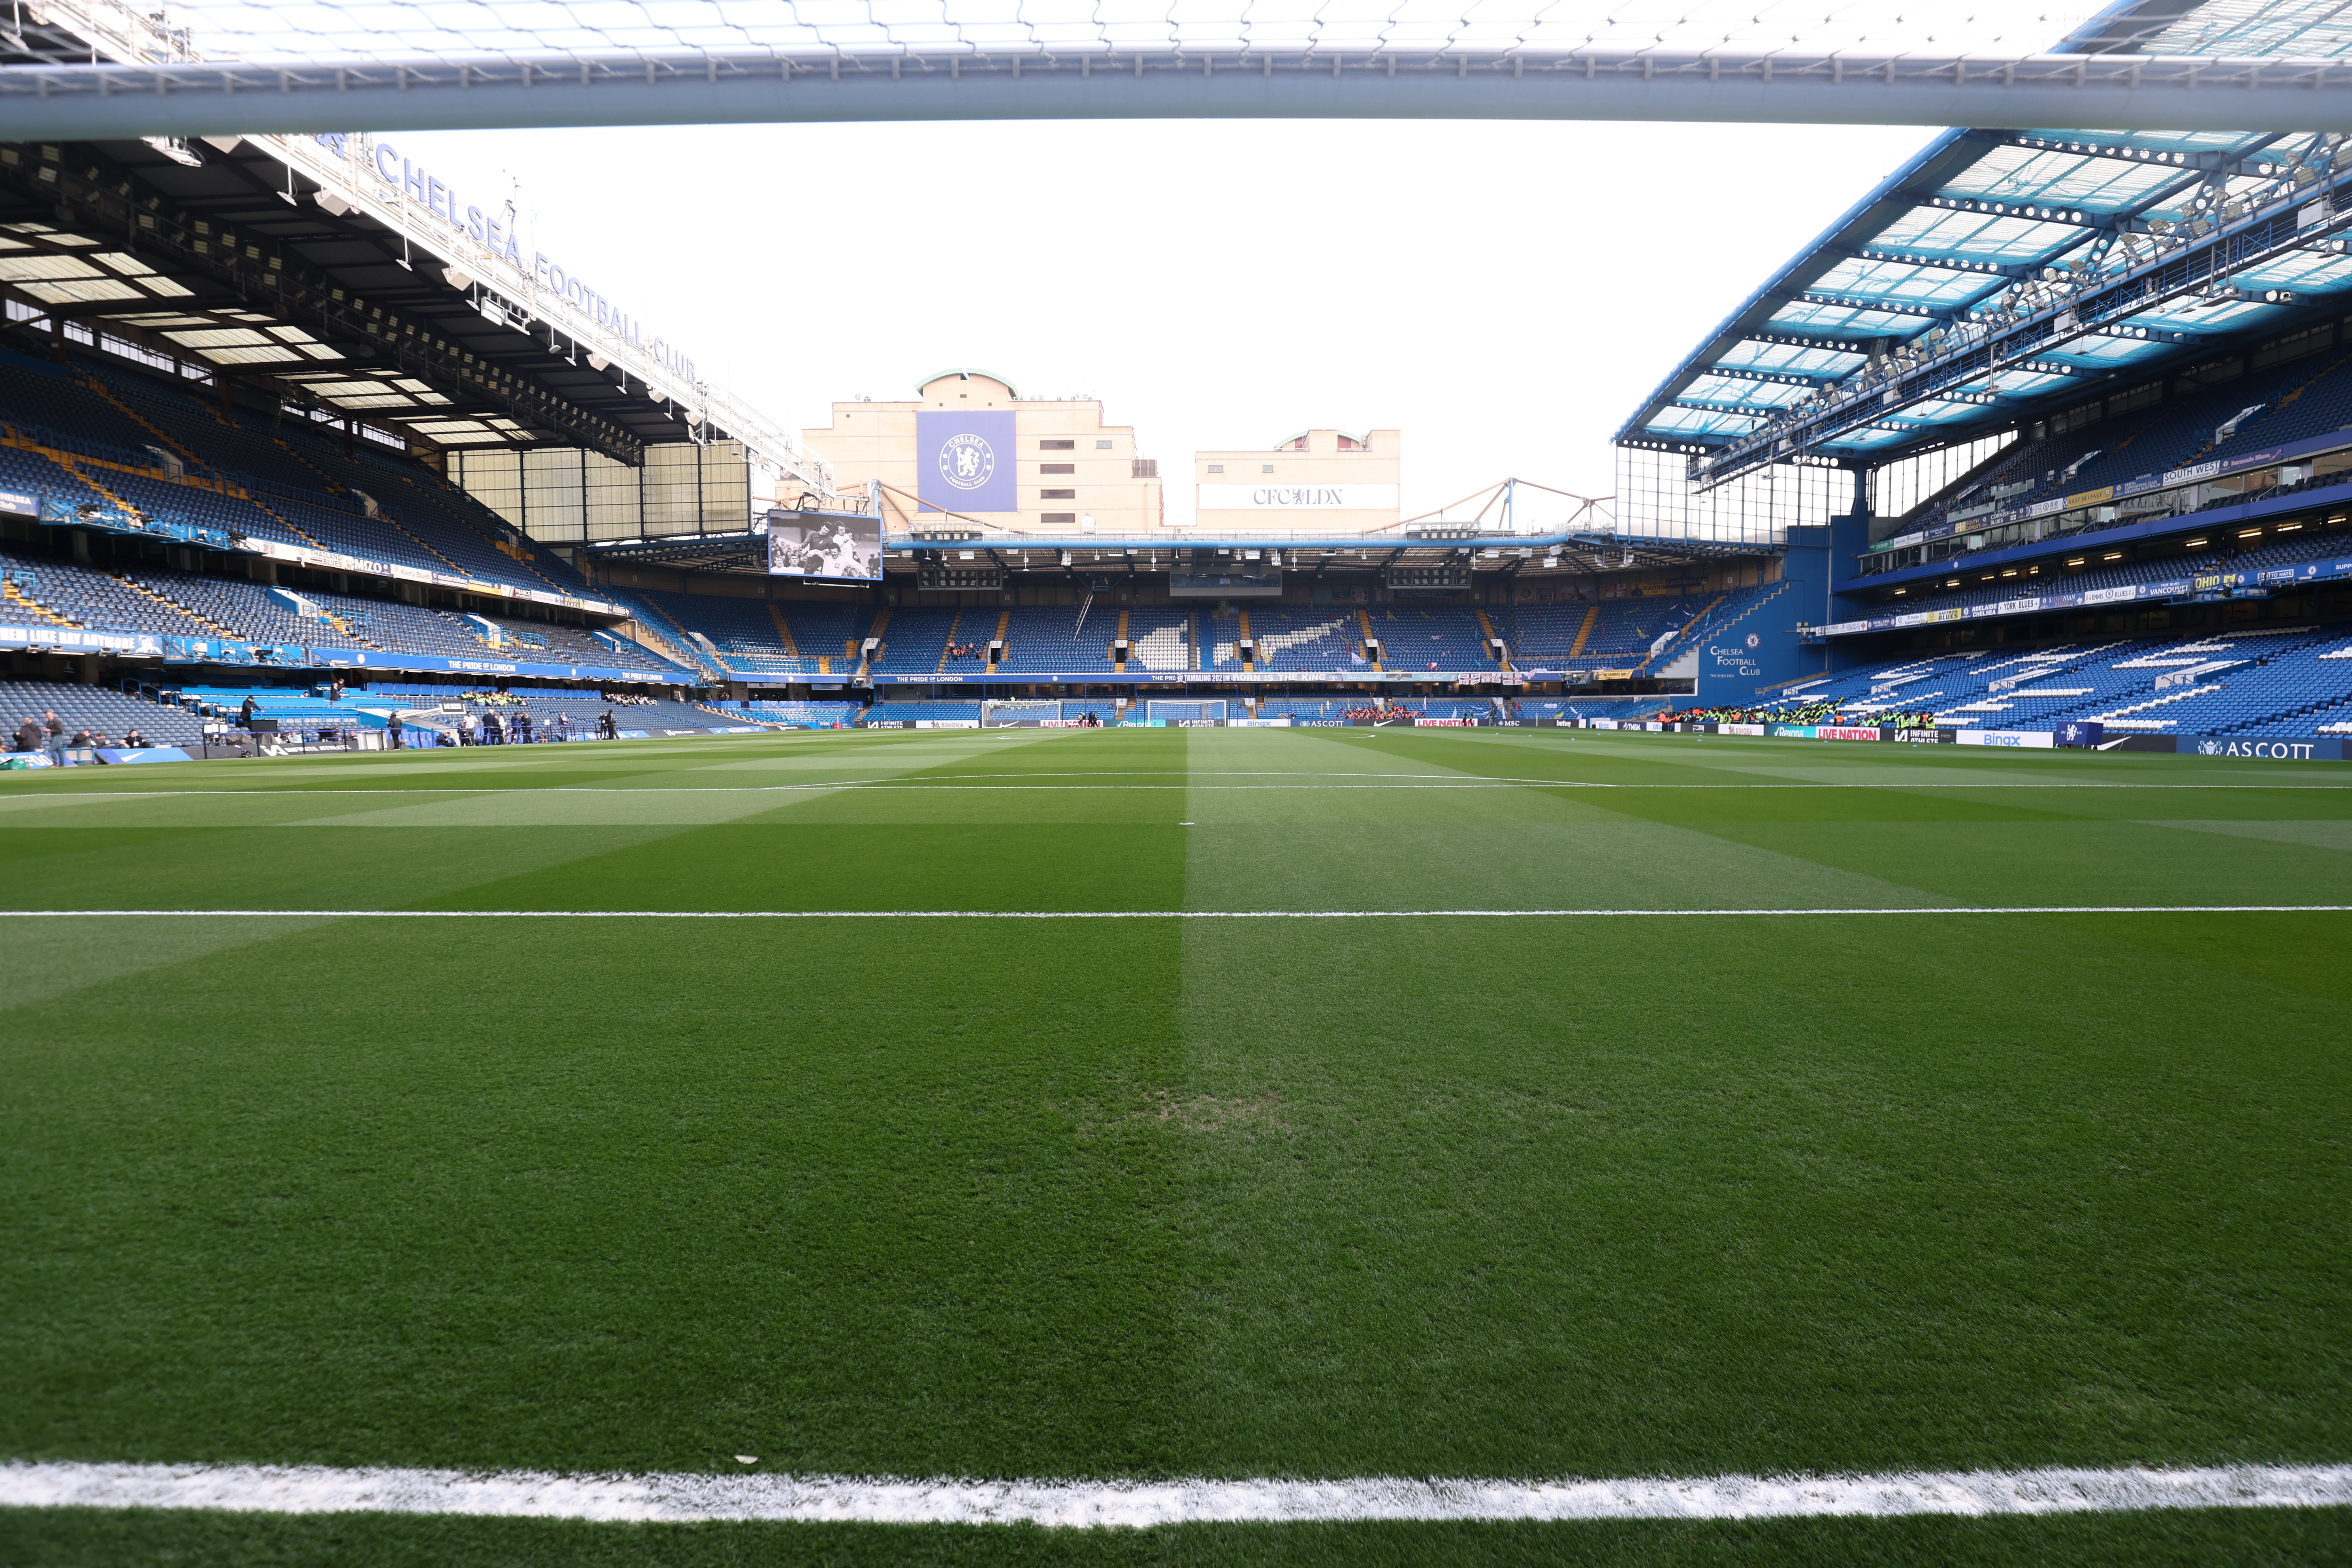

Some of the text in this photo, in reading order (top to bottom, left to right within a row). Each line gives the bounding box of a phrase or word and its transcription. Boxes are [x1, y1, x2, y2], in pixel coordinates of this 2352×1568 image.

[376, 143, 696, 383] CHELSEA FOOTBALL CLUB
[948, 435, 984, 449] CHELSEA
[2231, 456, 2254, 466] Bermuda
[2164, 461, 2219, 481] SOUTH WEST
[949, 475, 986, 487] FOOTBALL CLUB
[2124, 482, 2147, 491] SUPPORTERS
[2141, 483, 2161, 491] AUSTRALIA
[1254, 488, 1343, 505] CFC LDN
[2081, 492, 2103, 502] BELFAST
[1990, 511, 2010, 520] CORNISH
[311, 550, 342, 561] THAILAND
[354, 558, 382, 573] MIZO
[401, 569, 430, 580] Kerry Blues
[2195, 575, 2220, 589] OHIO
[515, 588, 531, 596] FRANCE
[2049, 594, 2076, 603] SLOVENIAN
[1972, 603, 1997, 612] ADELAIDE
[2004, 602, 2016, 610] YORK
[2018, 600, 2034, 609] BLUES
[1972, 609, 1996, 617] CHELSEA
[0, 628, 136, 649] HEM LIKE RAY ANYMORE
[1710, 646, 1744, 655] CHELSEA
[1717, 656, 1757, 665] FOOTBALL
[448, 660, 461, 668] THE
[463, 661, 482, 670] PRIDE
[490, 663, 516, 672] LONDON
[1740, 666, 1761, 675] CLUB
[1556, 719, 1572, 728] betway
[1779, 727, 1804, 737] Rexona
[1819, 728, 1877, 741] LIVE NATION
[1910, 730, 1939, 738] INFINITE
[2226, 742, 2314, 759] ASCOTT
